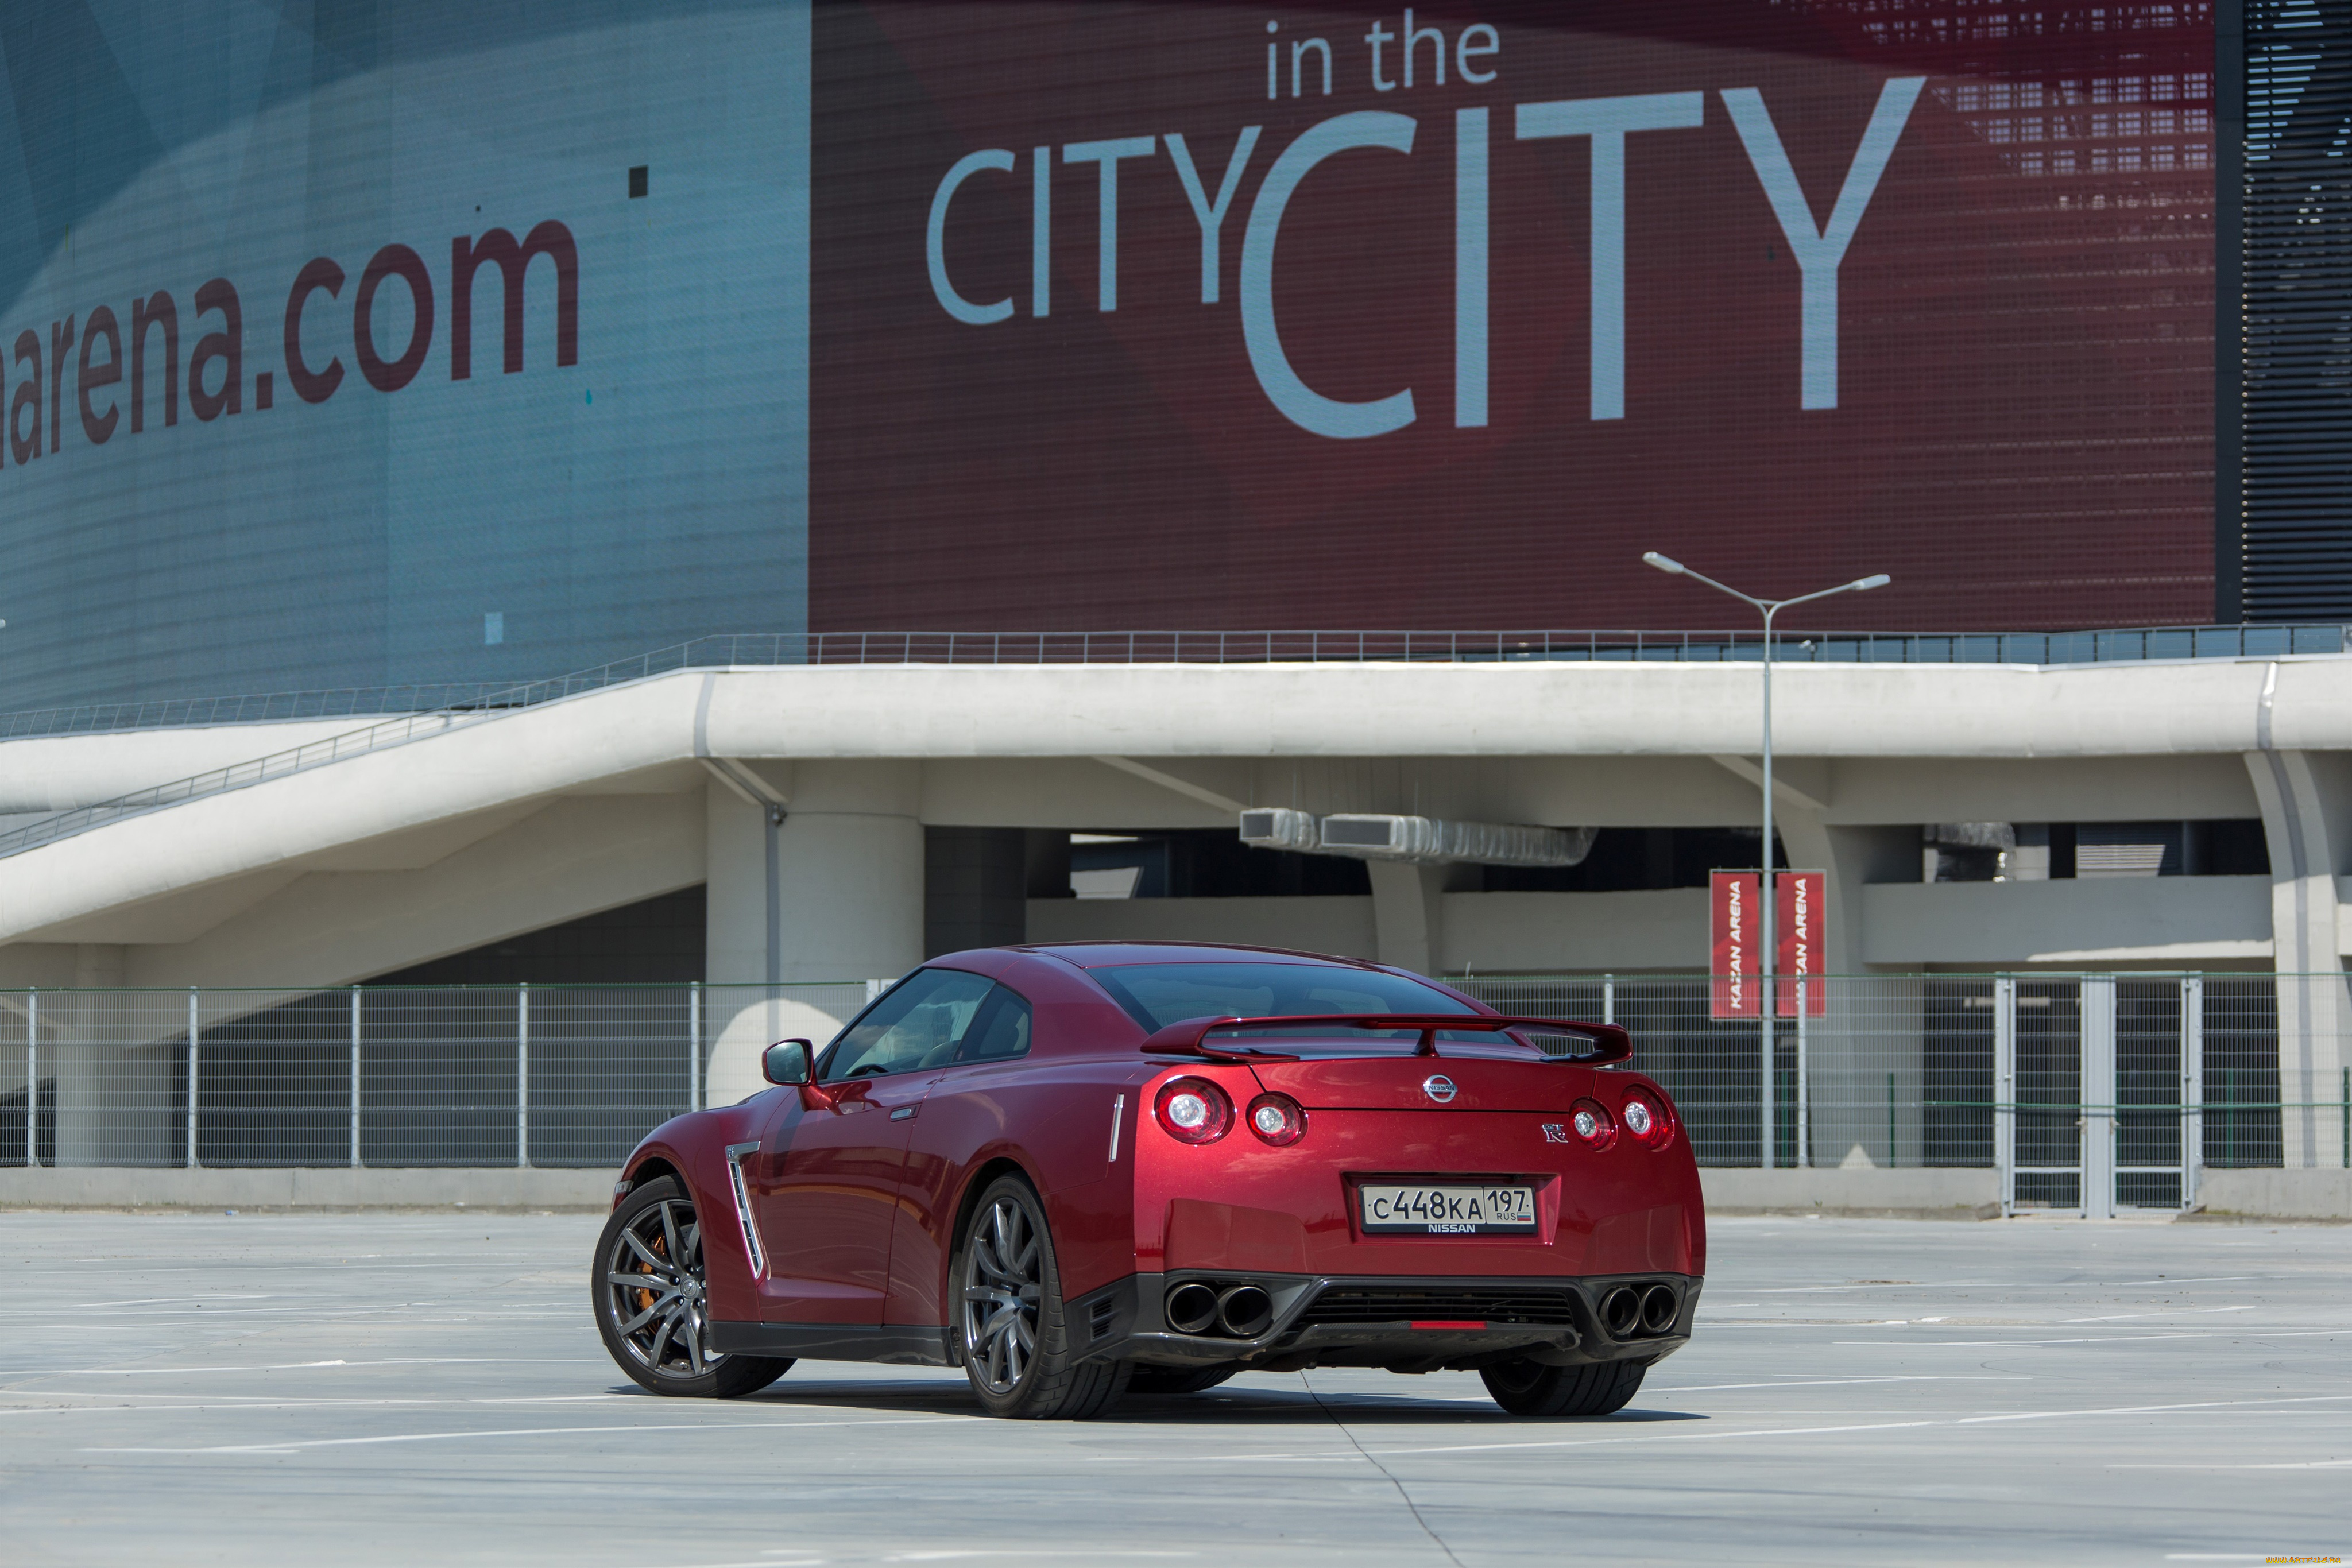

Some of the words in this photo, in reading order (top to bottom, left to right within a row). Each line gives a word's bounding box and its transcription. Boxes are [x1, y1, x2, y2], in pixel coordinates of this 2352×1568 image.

[1266, 20, 1332, 100] in
[1364, 7, 1500, 91] the
[926, 126, 1262, 324] CITY
[1240, 76, 1927, 439] CITY
[0, 219, 578, 470] arena.com
[1730, 881, 1741, 942] ARENA
[1795, 878, 1807, 940] ARENA
[1730, 946, 1742, 1009] KAZAN
[1374, 1190, 1483, 1219] C448KA
[1487, 1190, 1525, 1212] 197
[1428, 1224, 1476, 1233] NISSAN
[1496, 1213, 1517, 1221] RUS
